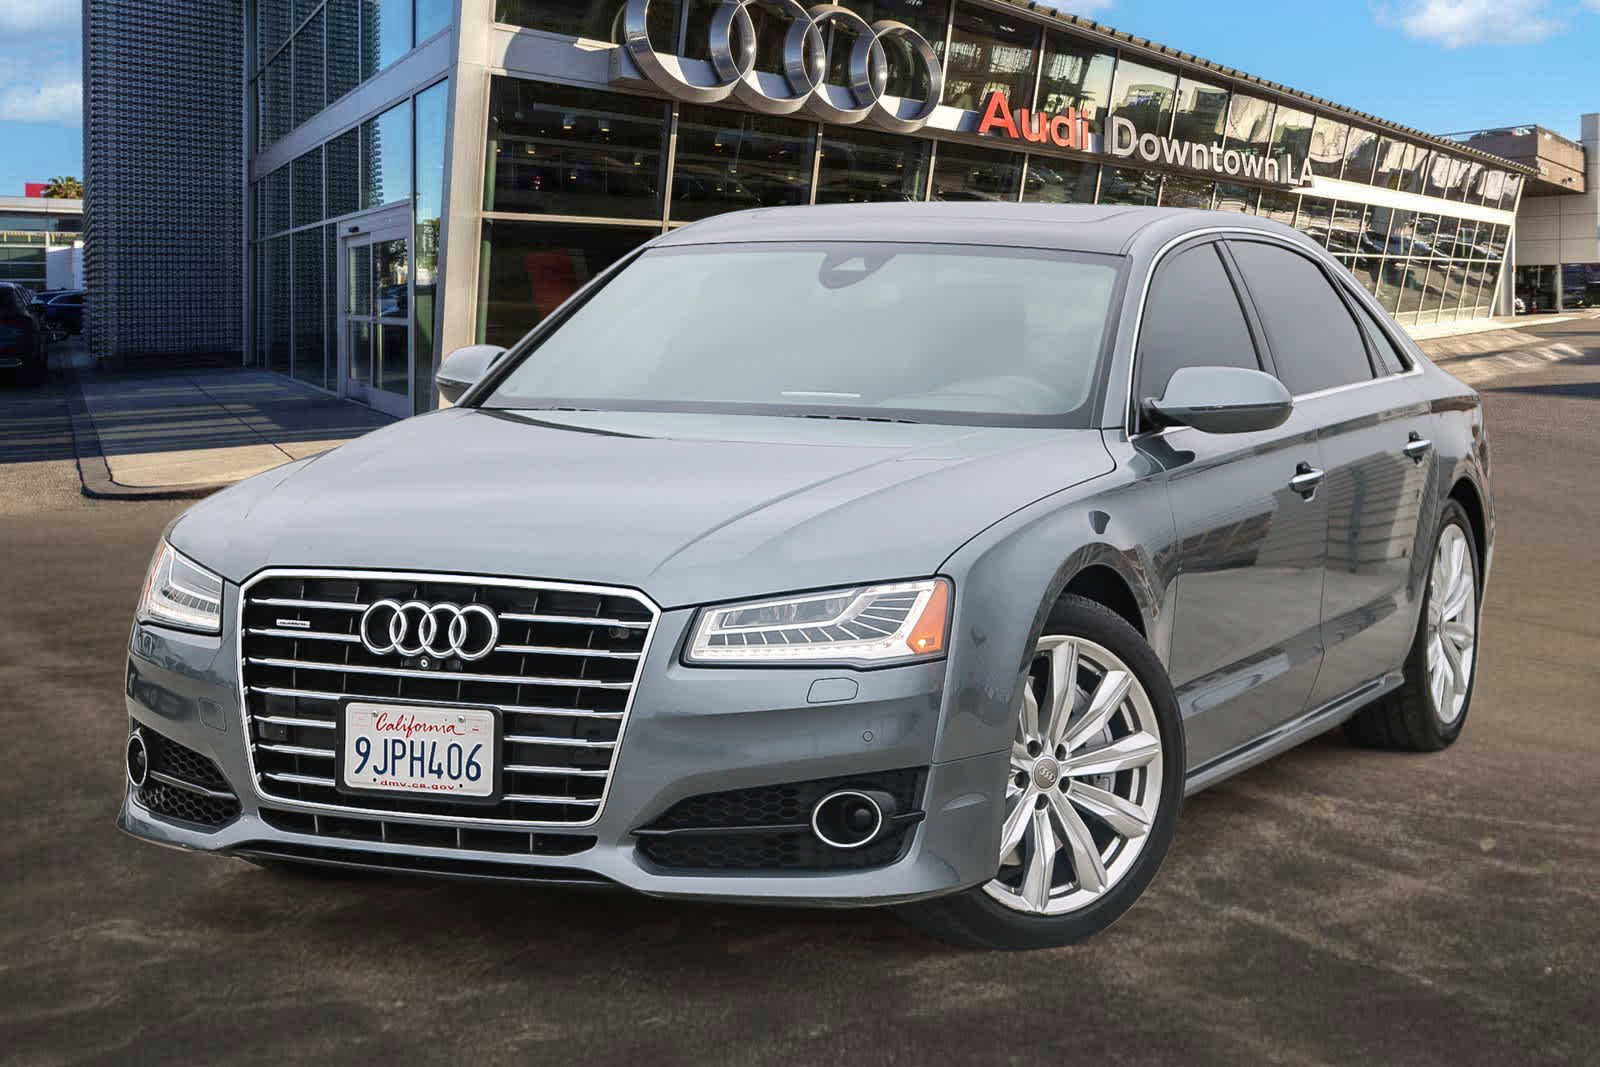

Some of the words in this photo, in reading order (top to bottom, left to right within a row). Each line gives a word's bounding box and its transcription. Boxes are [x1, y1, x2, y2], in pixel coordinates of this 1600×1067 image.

[978, 91, 1089, 150] Audi
[1111, 115, 1279, 182] Downtown
[376, 712, 465, 738] California
[354, 736, 483, 782] 9JPH406
[380, 779, 455, 791] dmv.ca.gov
